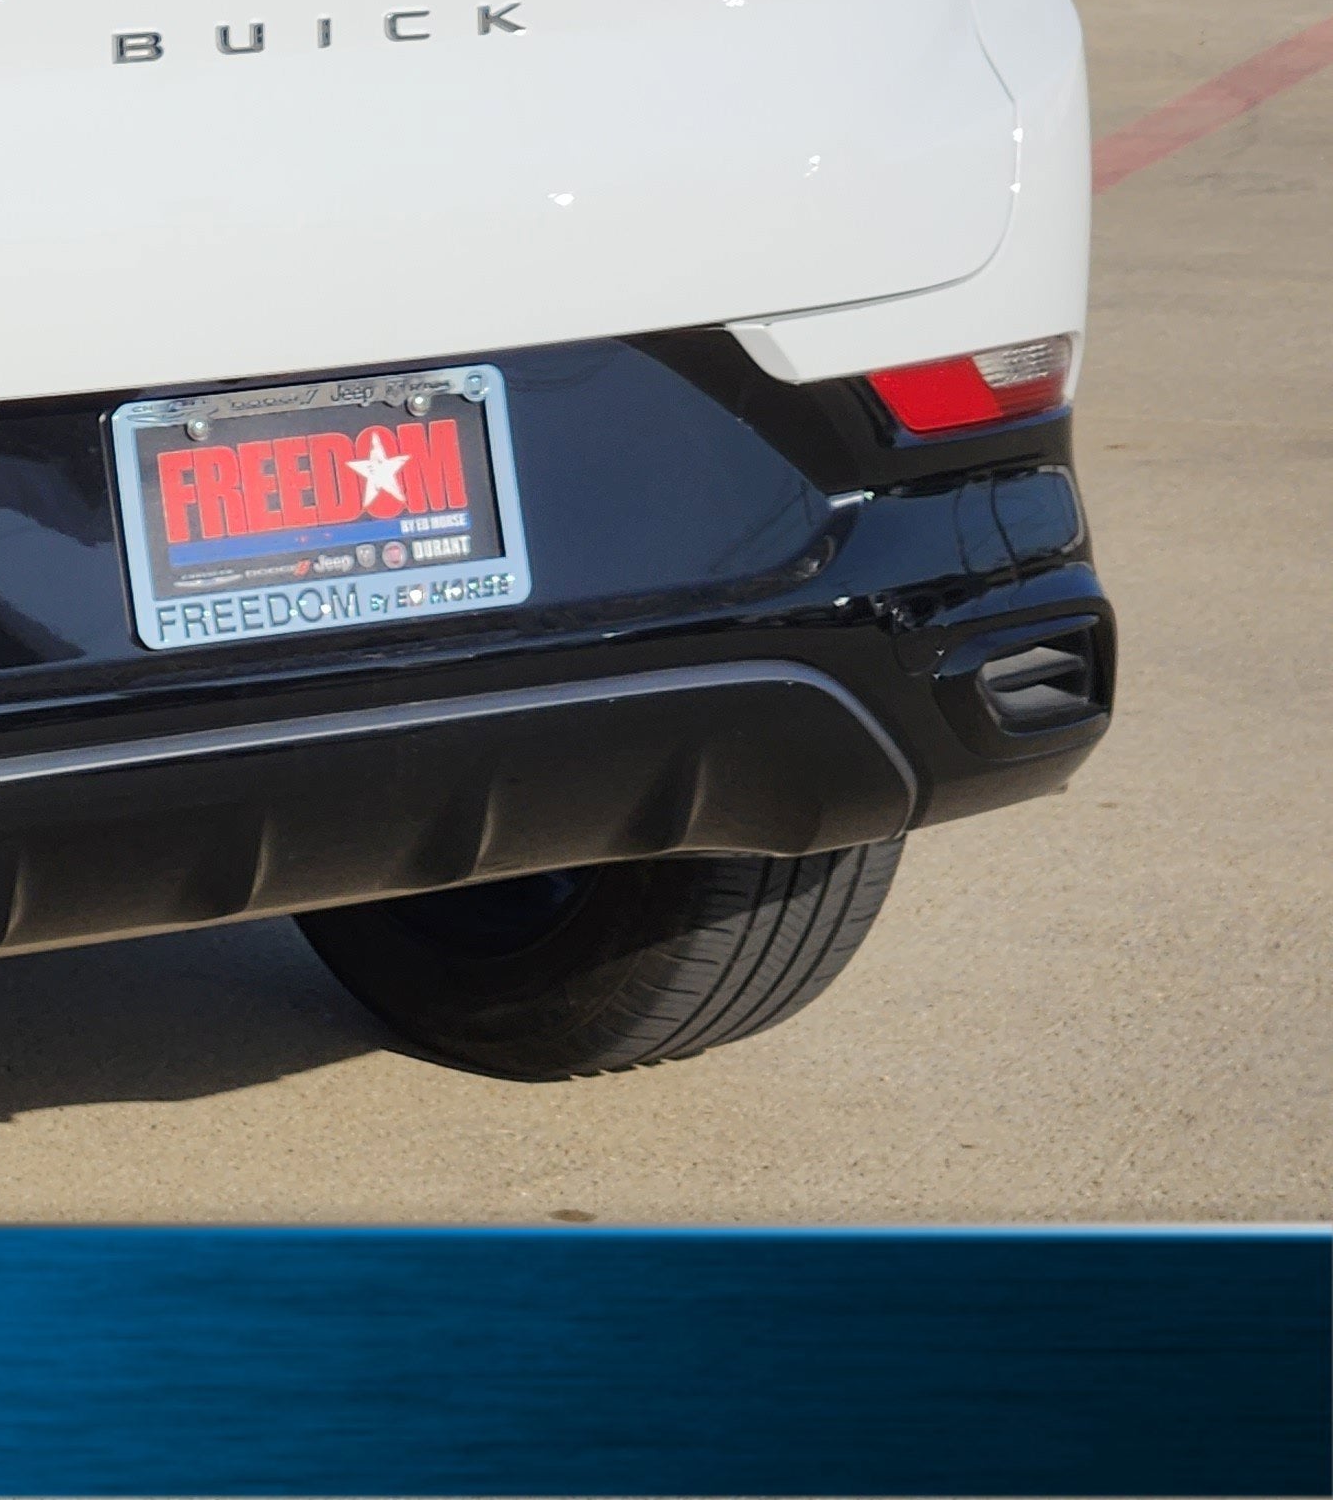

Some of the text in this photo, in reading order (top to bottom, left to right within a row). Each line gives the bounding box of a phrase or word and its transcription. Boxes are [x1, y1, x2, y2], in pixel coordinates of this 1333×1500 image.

[111, 2, 527, 64] BUICK
[331, 384, 373, 403] Jeep
[157, 419, 468, 544] FREEDOM
[313, 554, 354, 573] Jeep
[412, 535, 471, 561] DURANT
[156, 583, 361, 642] FREEDOM
[395, 584, 425, 608] ED
[429, 573, 515, 603] MORSE
